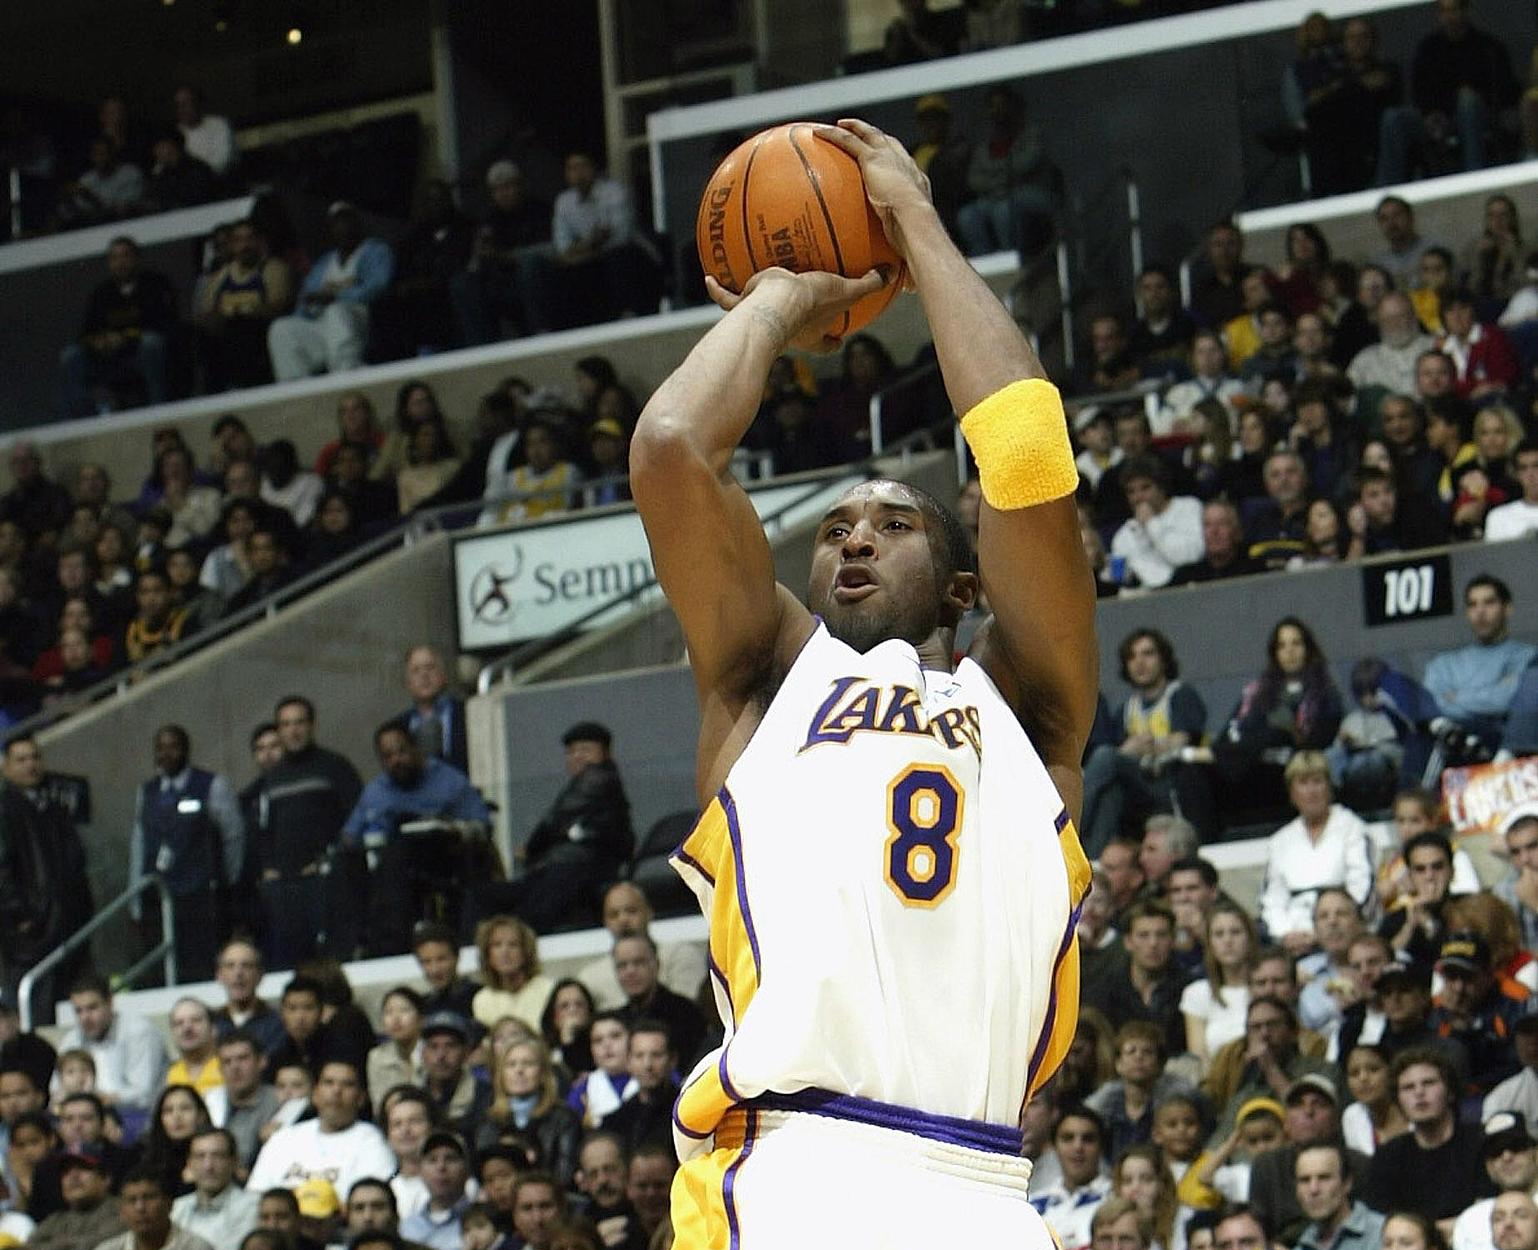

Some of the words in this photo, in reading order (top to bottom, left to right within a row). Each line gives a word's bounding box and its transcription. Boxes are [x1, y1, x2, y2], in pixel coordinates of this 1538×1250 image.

[1384, 565, 1434, 616] 101
[796, 676, 982, 760] LAKRS
[883, 762, 965, 910] 8
